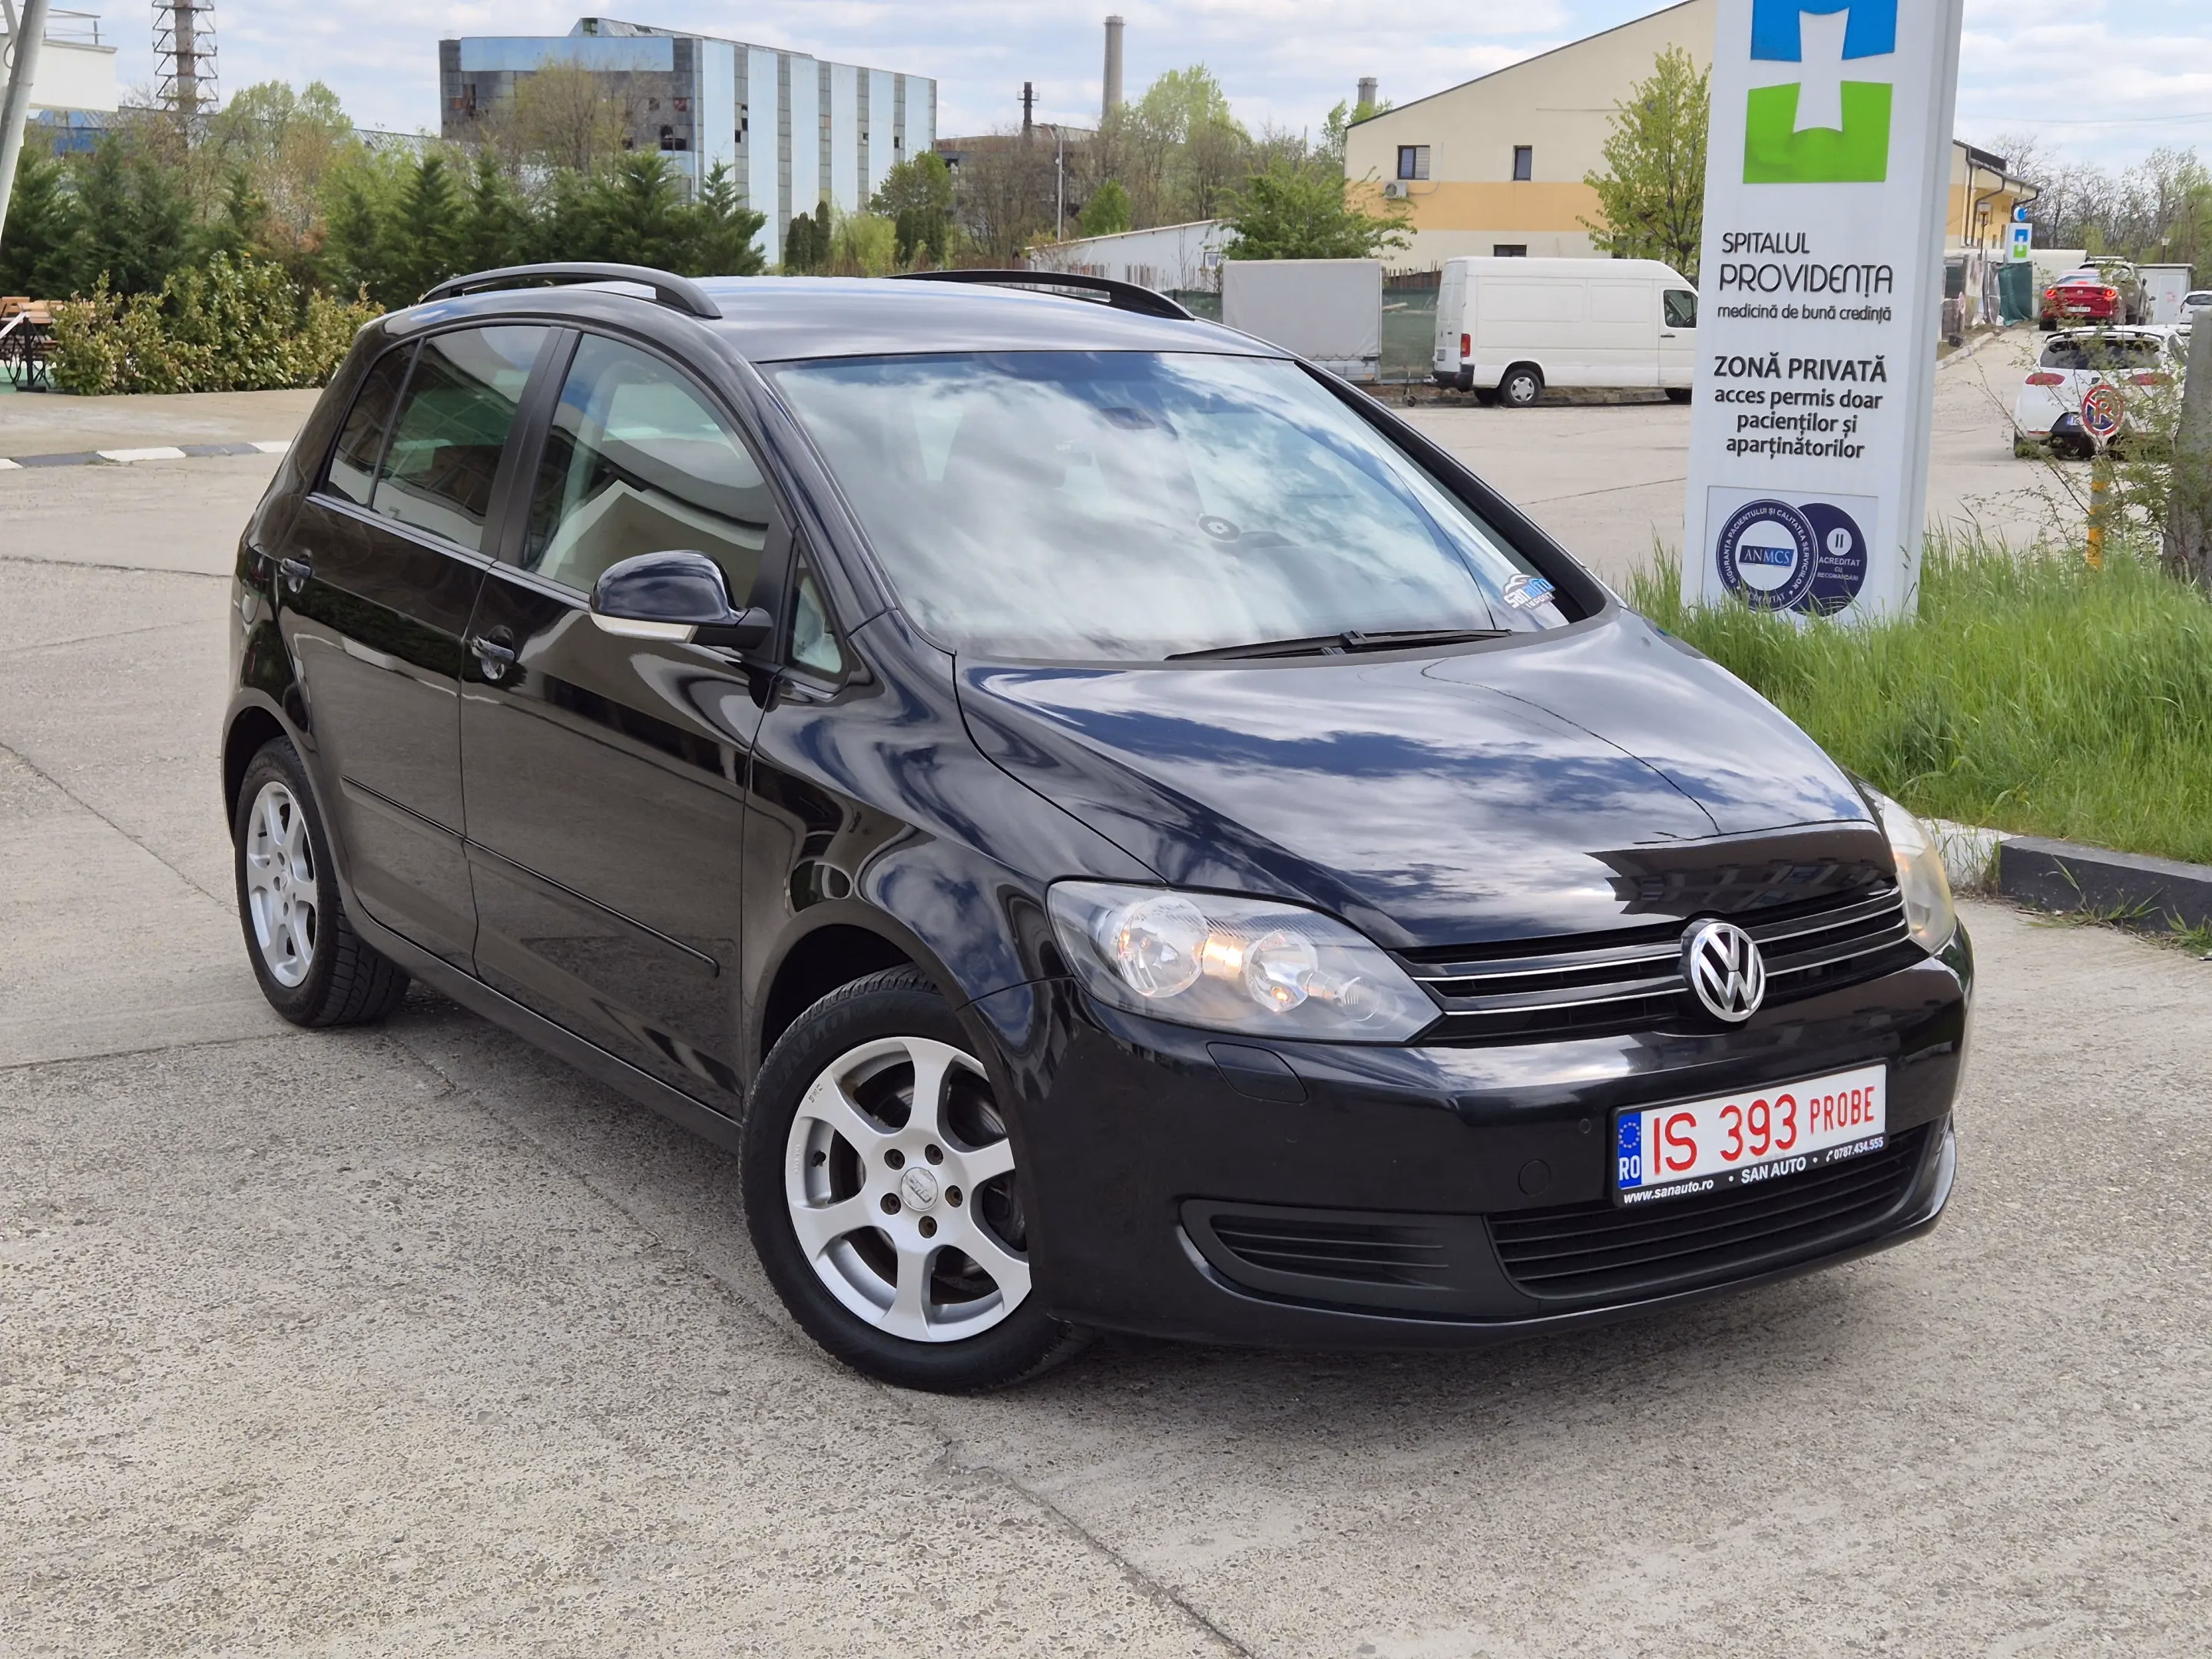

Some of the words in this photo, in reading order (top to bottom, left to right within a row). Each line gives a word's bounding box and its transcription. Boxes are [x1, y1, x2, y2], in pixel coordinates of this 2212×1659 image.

[1721, 232, 1810, 254] SPITALUL
[1719, 263, 1893, 297] PROVIDENȚA
[1717, 303, 1778, 319] medicină
[1781, 303, 1799, 320] de
[1802, 304, 1836, 320] bună
[1839, 305, 1892, 324] credință
[1714, 351, 1781, 379] ZONĂ
[1788, 354, 1887, 382] PRIVATĂ
[1714, 388, 1766, 404] acces
[1770, 388, 1835, 409] permis
[1839, 389, 1883, 409] doar
[1737, 410, 1839, 435] pacienților
[1842, 414, 1858, 439] și
[1726, 435, 1866, 459] aparținătorilor
[1727, 507, 1767, 538] PACIENTULUI
[1777, 509, 1807, 541] CALITATEA
[1743, 548, 1791, 565] ANMCS
[1818, 556, 1861, 567] ACREDITAT
[1653, 1111, 1697, 1176] IS
[1718, 1093, 1798, 1162] 393
[1810, 1085, 1876, 1135] PROBE
[1833, 1136, 1884, 1161] 0787.434.555
[1618, 1154, 1641, 1181] RO
[1740, 1164, 1769, 1184] SAN
[1770, 1157, 1807, 1178] AUTO
[1623, 1179, 1714, 1204] www.sanauto.ro
